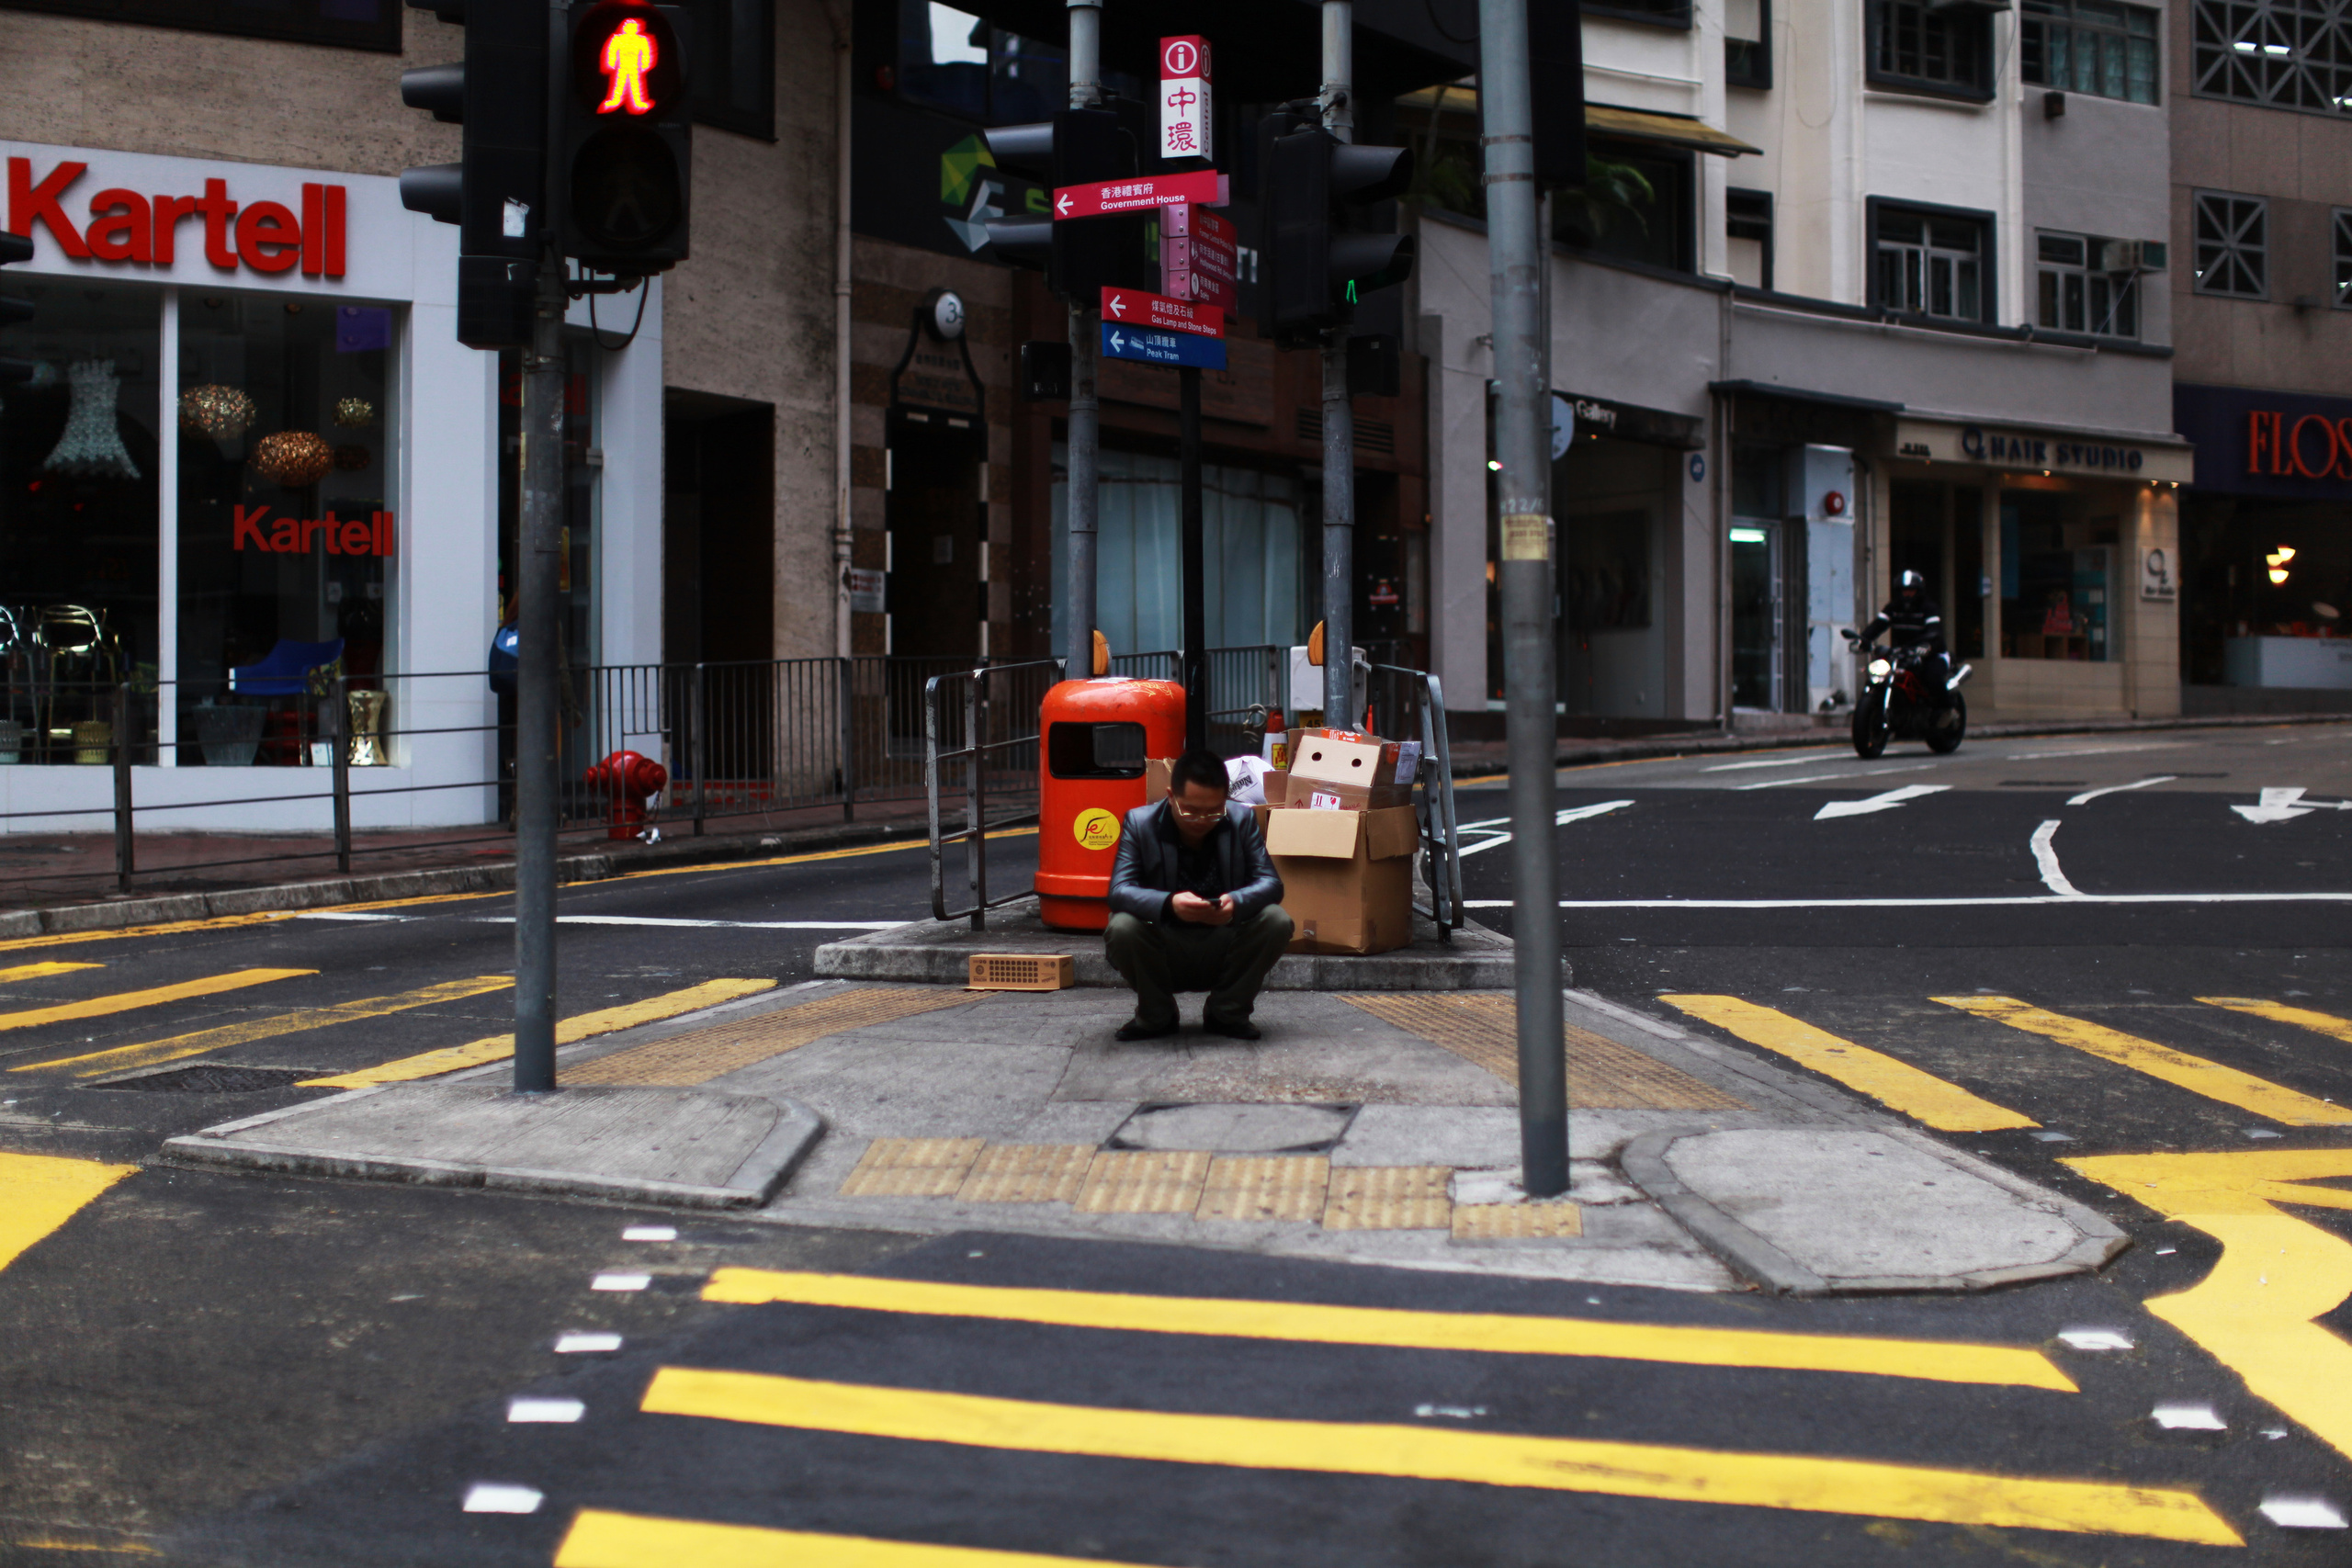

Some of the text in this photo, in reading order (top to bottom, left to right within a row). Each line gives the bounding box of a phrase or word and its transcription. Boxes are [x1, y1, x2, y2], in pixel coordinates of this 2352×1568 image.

[1168, 85, 1197, 152] 中環
[1101, 183, 1154, 199] 香港禮賓府
[1101, 194, 1185, 210] Government House
[6, 156, 347, 277] Kartell
[1151, 314, 1217, 336] Gas Lamp and Stone Steps
[1146, 333, 1177, 348] 山頂纜車
[1146, 348, 1180, 361] Peak Tram
[1991, 435, 2047, 463] HAIR
[2057, 442, 2143, 471] STUDIO
[233, 504, 394, 558] Kartell
